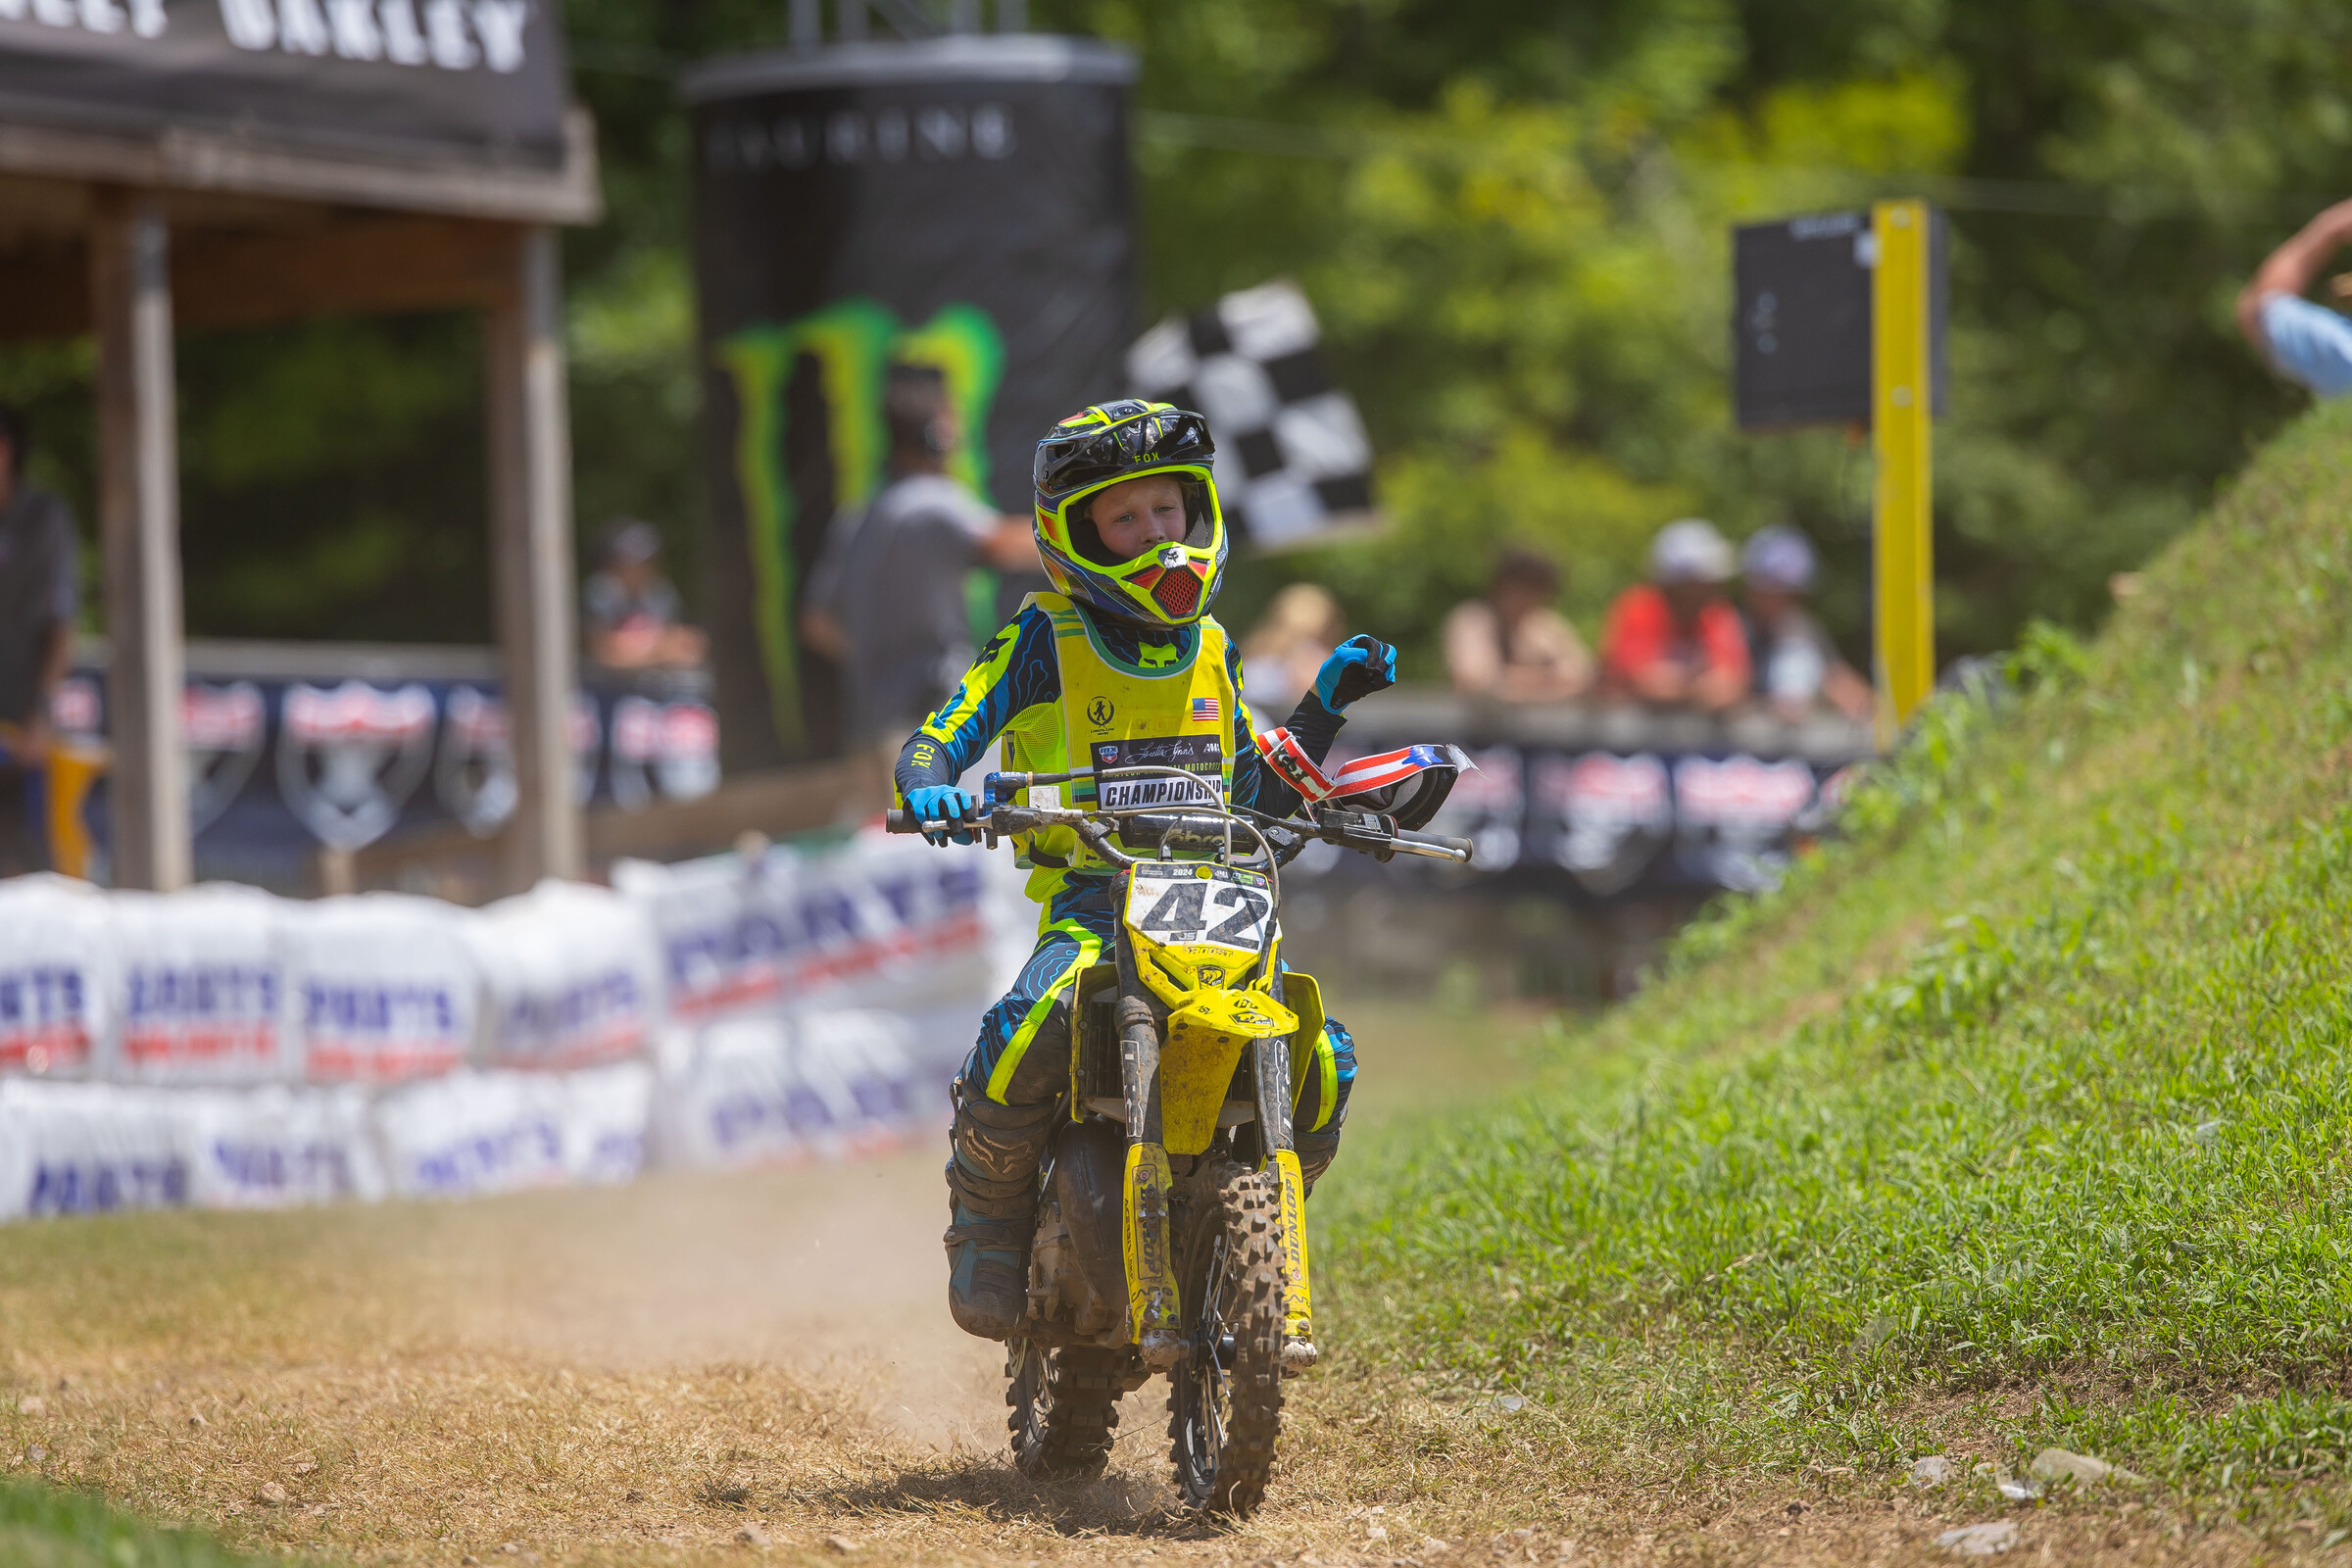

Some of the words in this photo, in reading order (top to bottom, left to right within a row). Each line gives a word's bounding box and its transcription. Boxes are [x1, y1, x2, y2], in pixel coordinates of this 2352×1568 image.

[1134, 452, 1160, 465] FOX
[911, 744, 935, 768] FOX
[1140, 882, 1269, 951] 42
[1285, 1178, 1300, 1265] DUNLOP
